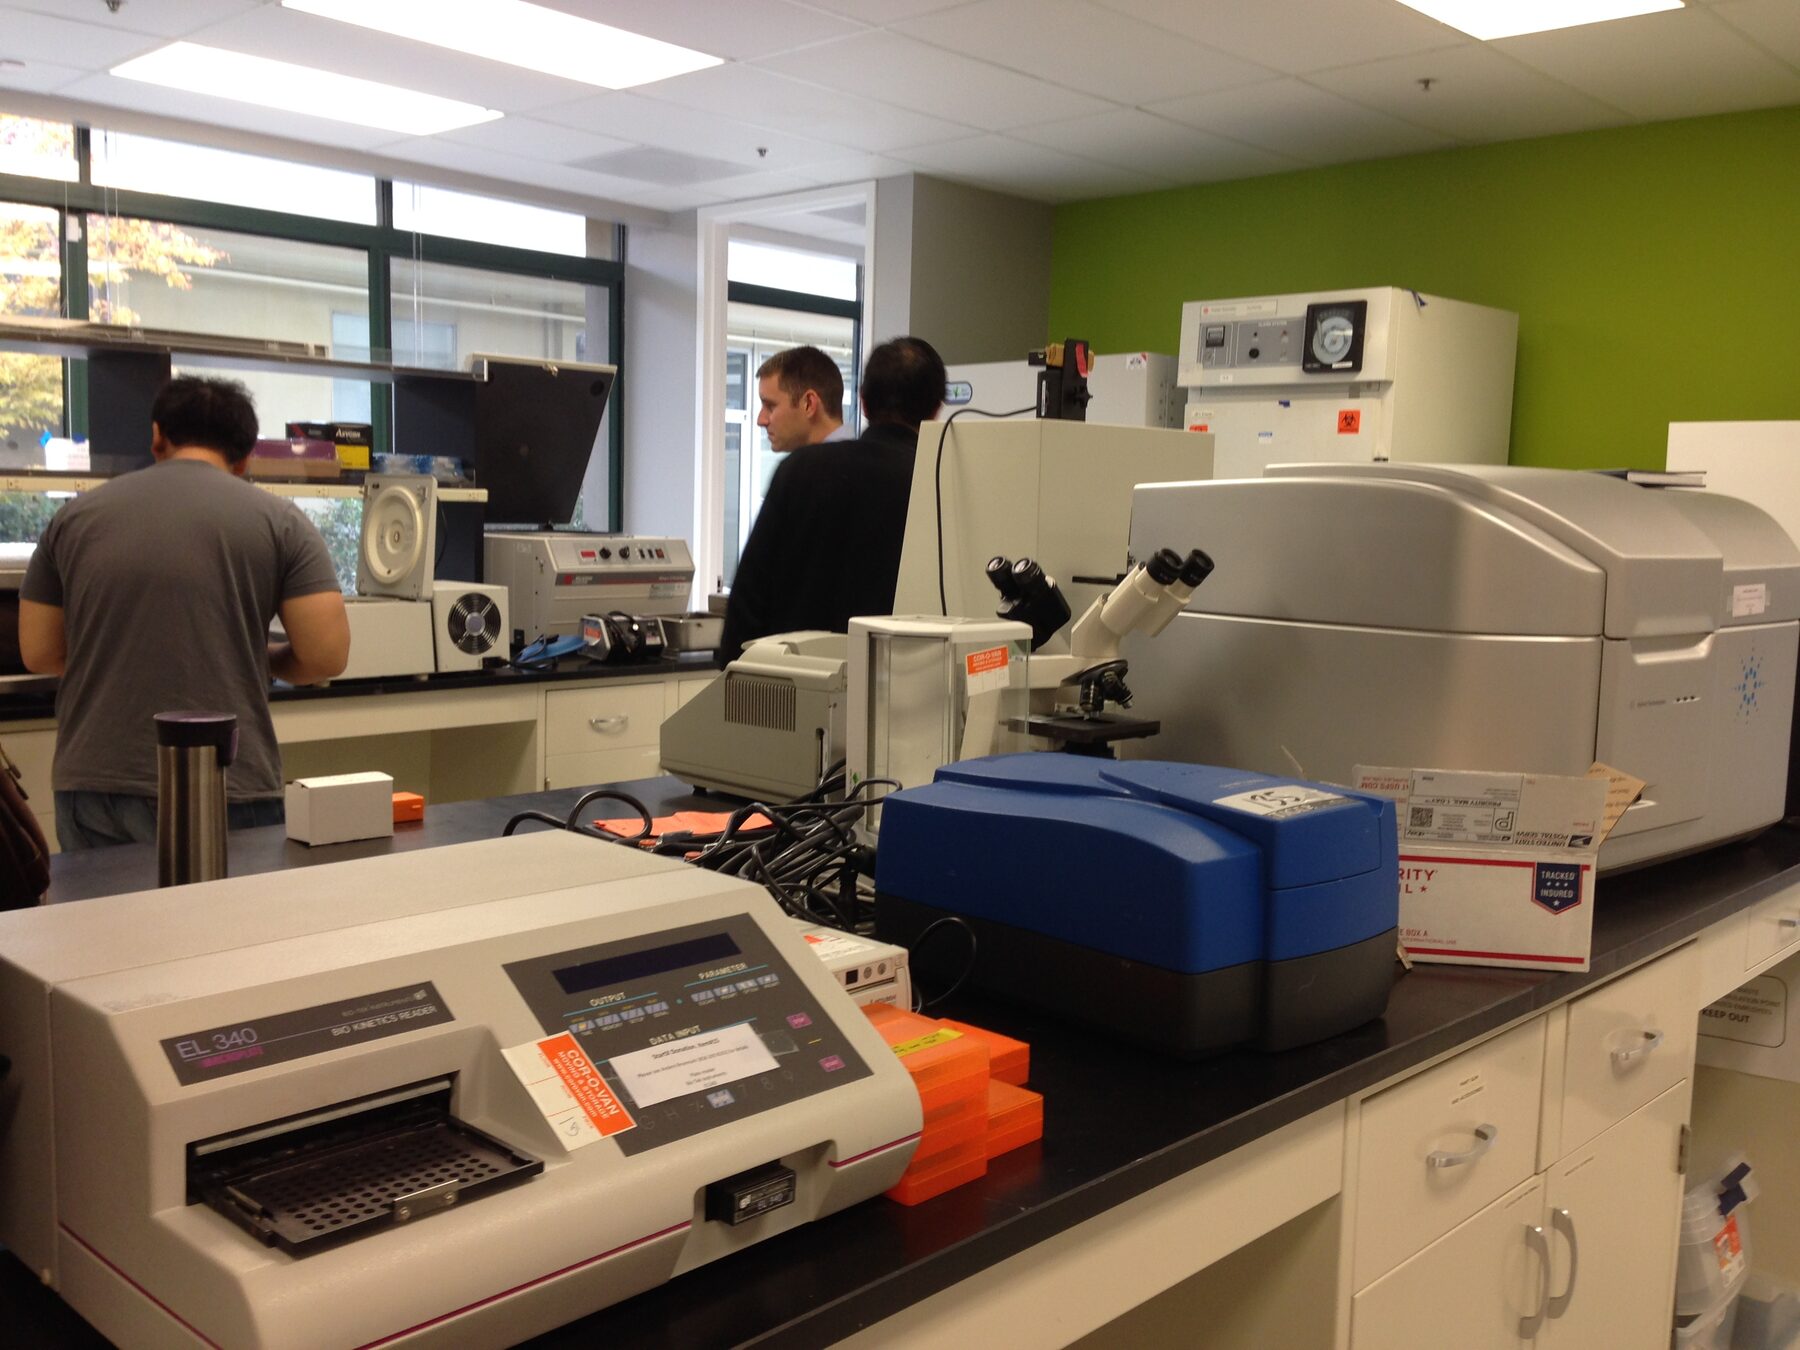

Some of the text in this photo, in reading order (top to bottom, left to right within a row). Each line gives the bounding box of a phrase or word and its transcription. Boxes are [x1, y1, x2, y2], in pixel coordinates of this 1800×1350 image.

[1541, 870, 1575, 880] TRACKED
[1540, 889, 1574, 898] INSURED
[698, 963, 748, 980] PARAMETER
[589, 992, 626, 1007] OUTPUT
[331, 1004, 438, 1036] BIO KINETICS READER
[1702, 1008, 1750, 1023] KEEP OUT
[175, 1040, 211, 1060] EL
[212, 1027, 258, 1051] 340
[649, 1024, 701, 1046] DATA INPUT
[558, 1051, 581, 1079] MOVING
[582, 1086, 610, 1119] STORAGE
[566, 1049, 620, 1116] COR-O-VAN
